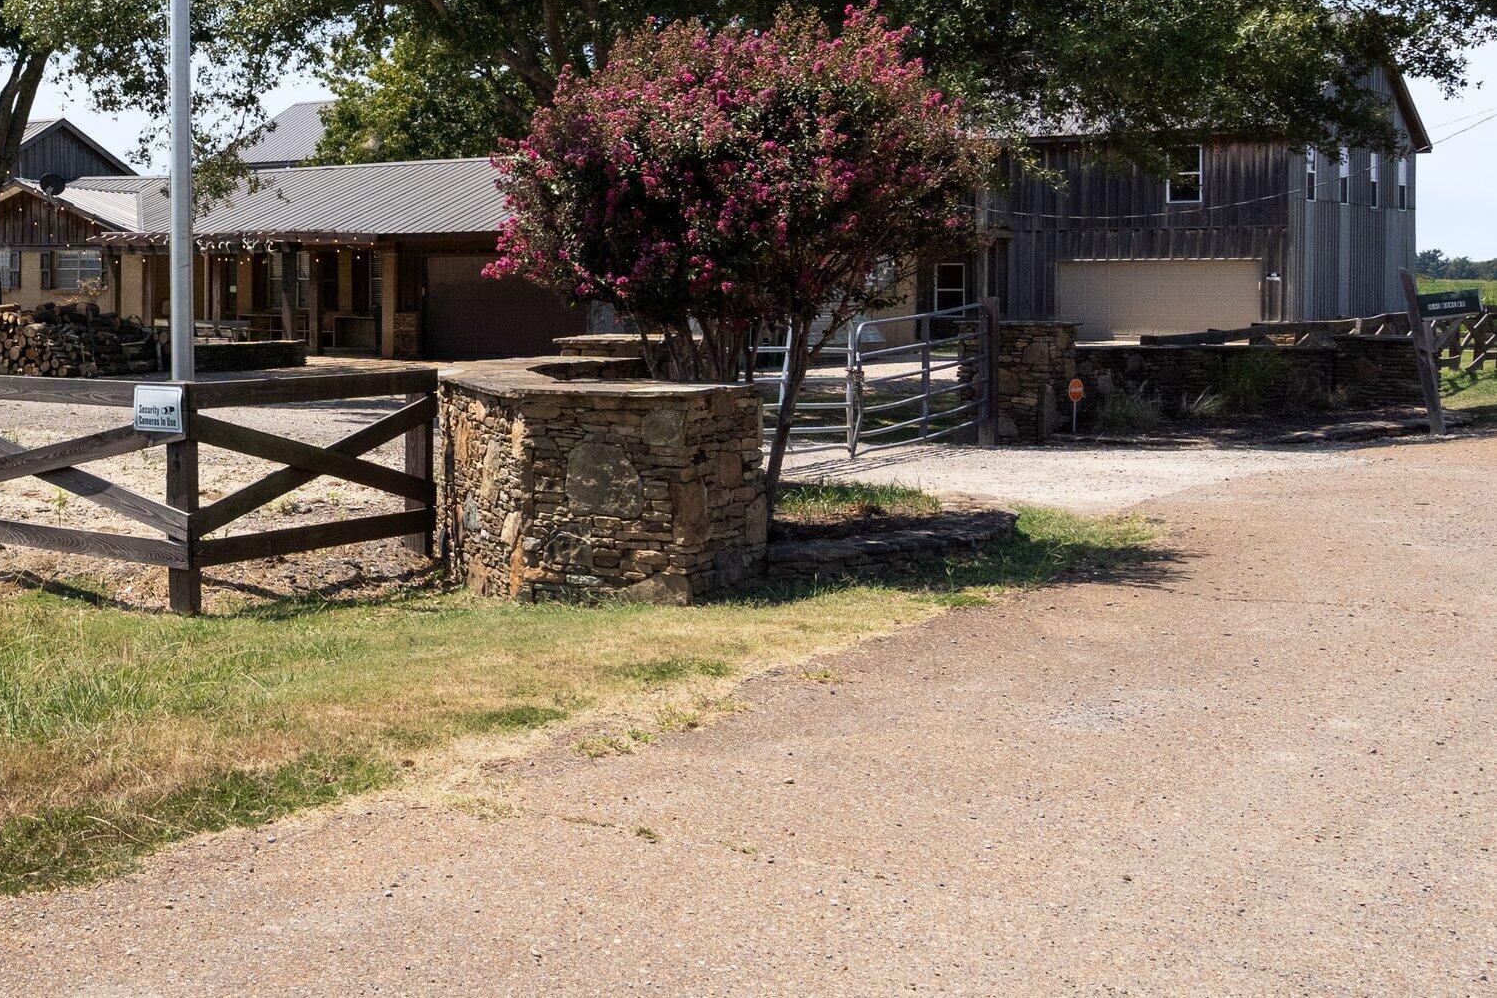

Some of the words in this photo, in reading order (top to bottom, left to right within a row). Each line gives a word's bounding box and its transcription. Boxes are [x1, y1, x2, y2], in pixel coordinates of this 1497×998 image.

[139, 404, 159, 416] Security
[139, 416, 159, 425] Cameras
[167, 417, 176, 426] Use
